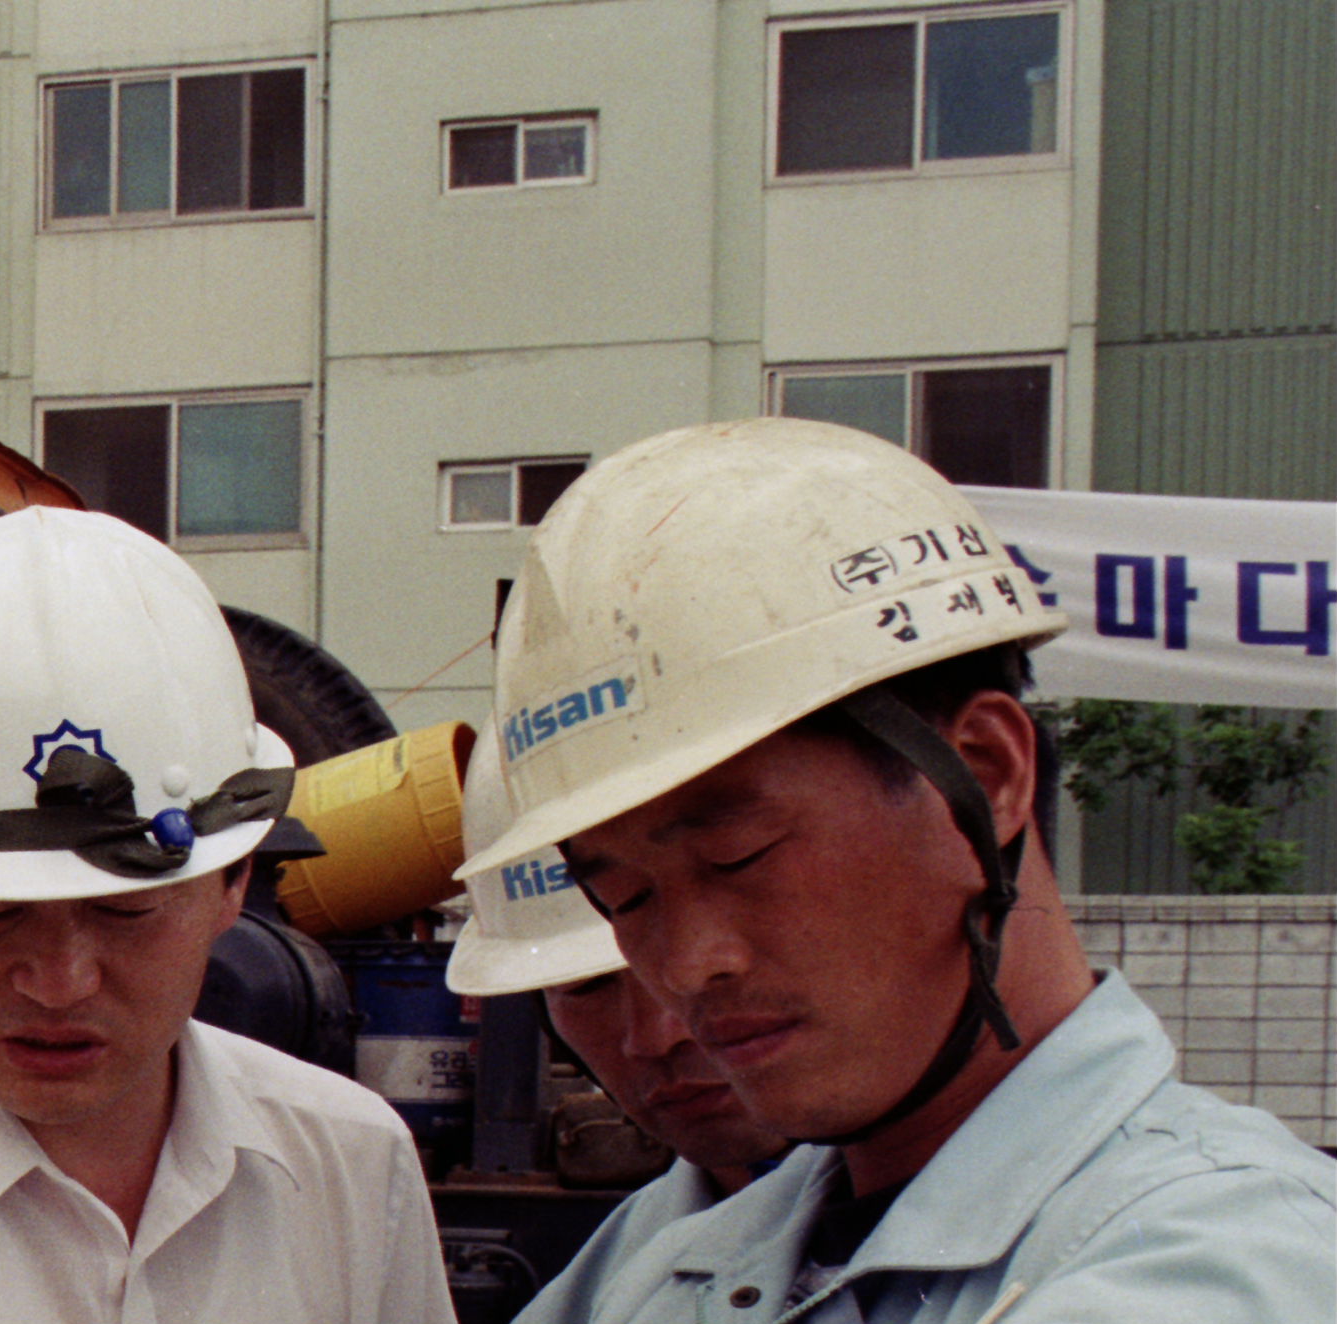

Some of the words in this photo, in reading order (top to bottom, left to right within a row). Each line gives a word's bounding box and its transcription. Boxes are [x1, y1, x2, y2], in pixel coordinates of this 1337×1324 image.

[1005, 545, 1337, 655] 마다
[503, 678, 627, 762] Kisan
[501, 860, 576, 902] Kis
